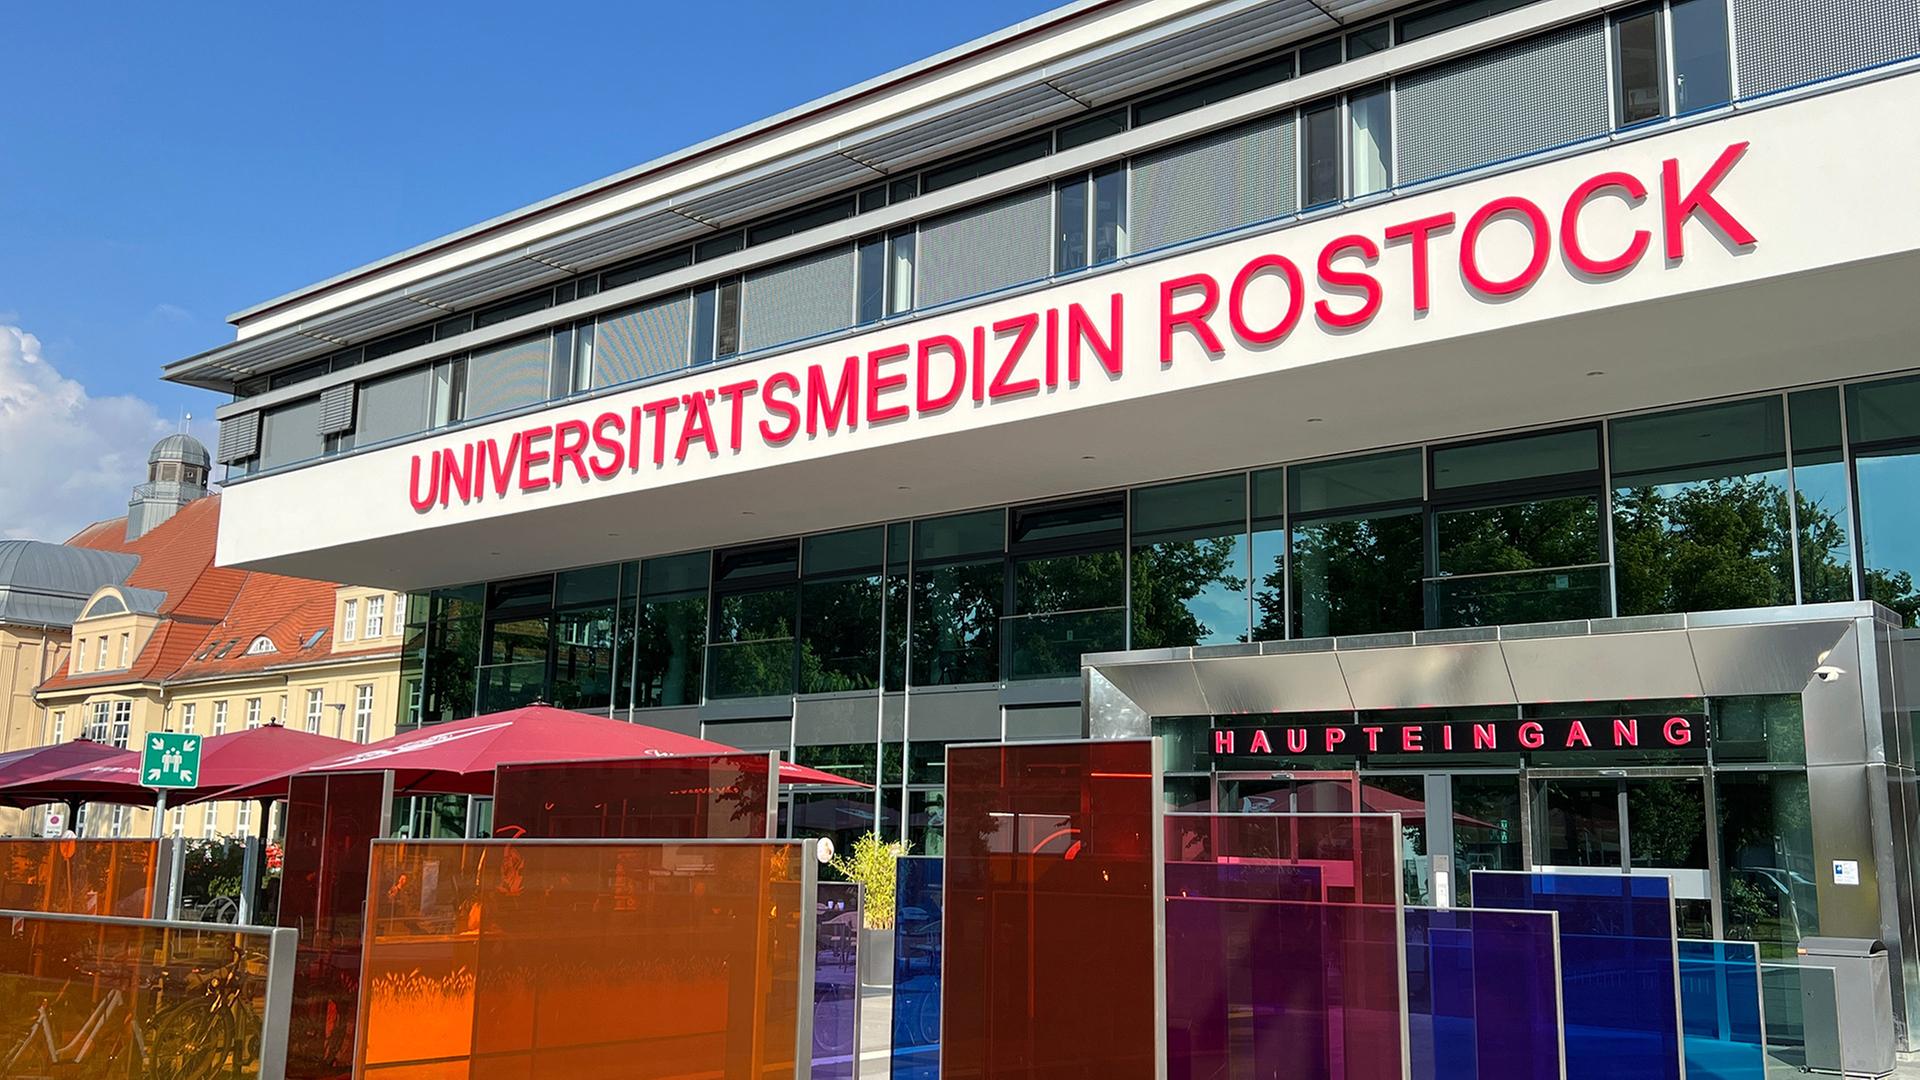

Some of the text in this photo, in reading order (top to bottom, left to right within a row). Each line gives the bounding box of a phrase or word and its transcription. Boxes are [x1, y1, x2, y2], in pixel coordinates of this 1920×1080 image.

[409, 142, 1757, 512] UNIVERSITÄTSMEDIZIN ROSTOCK
[1214, 717, 1693, 754] HAUPTEINGANG
